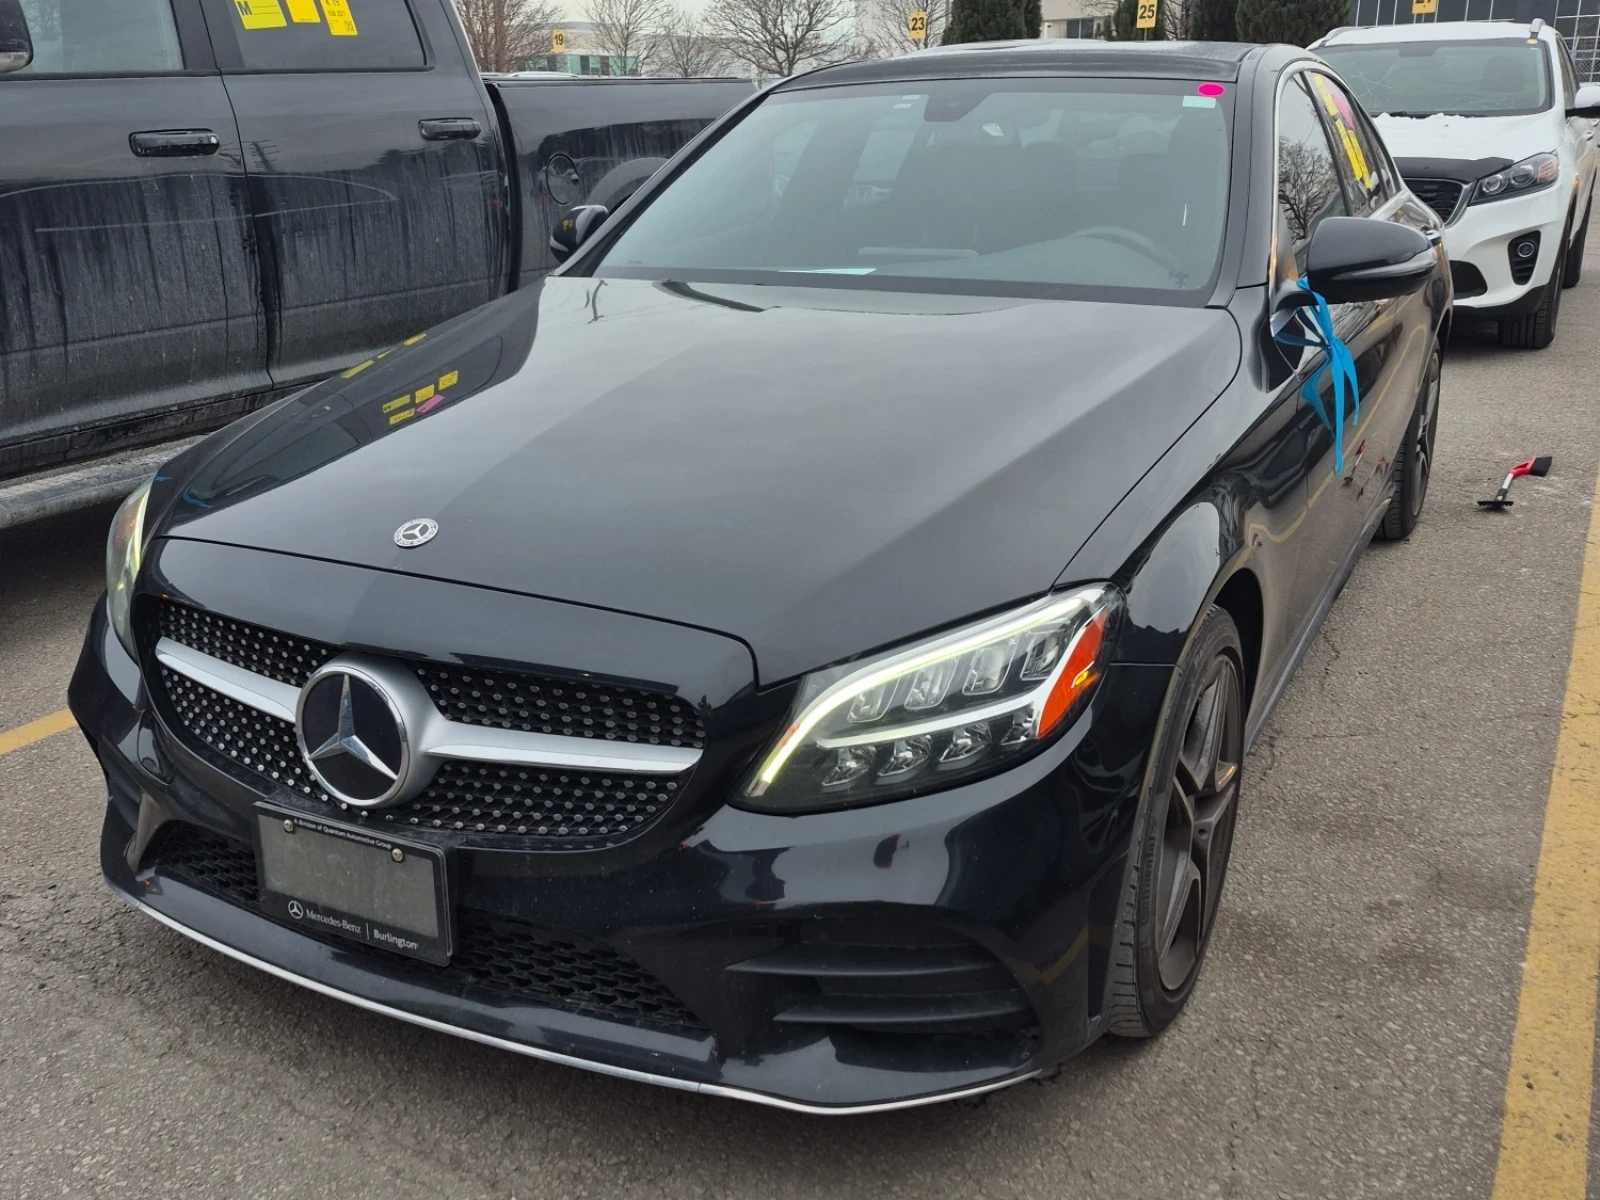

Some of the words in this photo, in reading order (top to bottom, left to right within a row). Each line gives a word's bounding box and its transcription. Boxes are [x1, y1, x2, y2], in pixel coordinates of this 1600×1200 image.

[236, 1, 253, 16] M
[1138, 4, 1155, 19] 25
[911, 16, 925, 31] 23
[554, 33, 564, 46] 19
[298, 820, 316, 829] division
[323, 826, 346, 836] Quantum
[346, 833, 375, 844] Automotive
[376, 840, 392, 850] Group
[306, 909, 361, 933] Mercedes-Benz
[373, 929, 418, 950] Burlington
